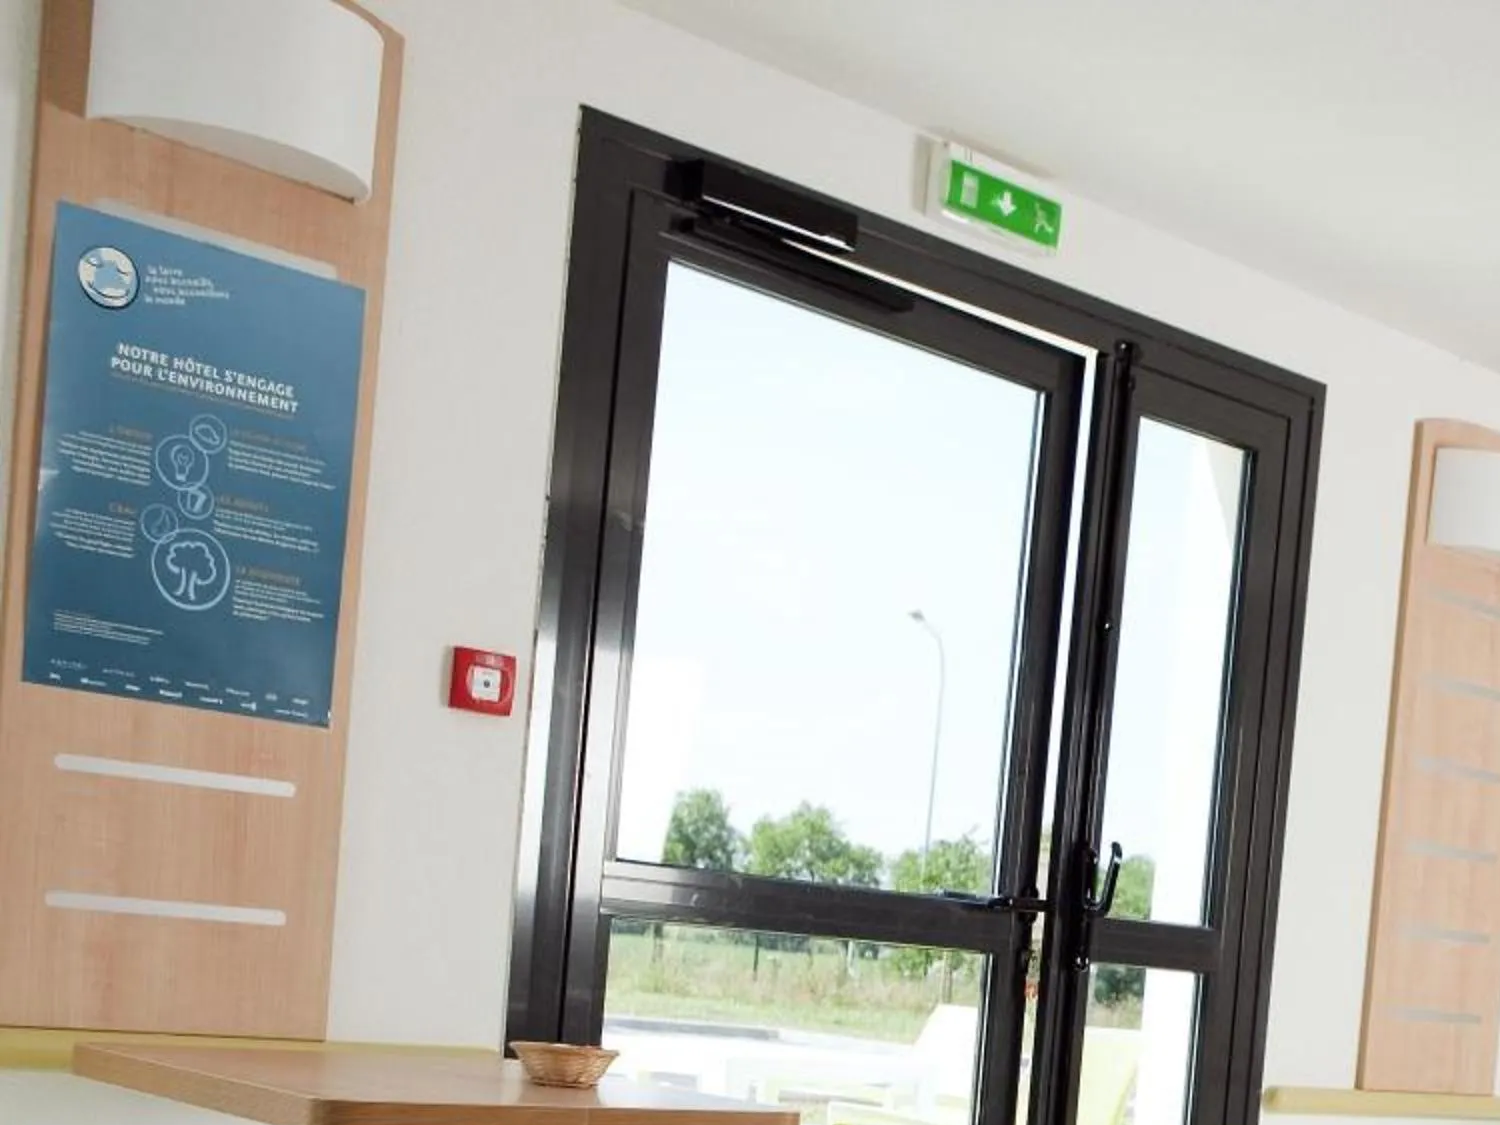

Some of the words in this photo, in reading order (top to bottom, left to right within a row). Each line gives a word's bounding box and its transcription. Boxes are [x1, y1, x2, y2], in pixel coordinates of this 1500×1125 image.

[110, 356, 153, 378] POUR
[157, 368, 299, 413] L'ENVIRONNEMENT
[117, 342, 169, 367] NOTRE
[173, 356, 220, 380] HÔTEL
[224, 368, 296, 399] S'ENGAGE
